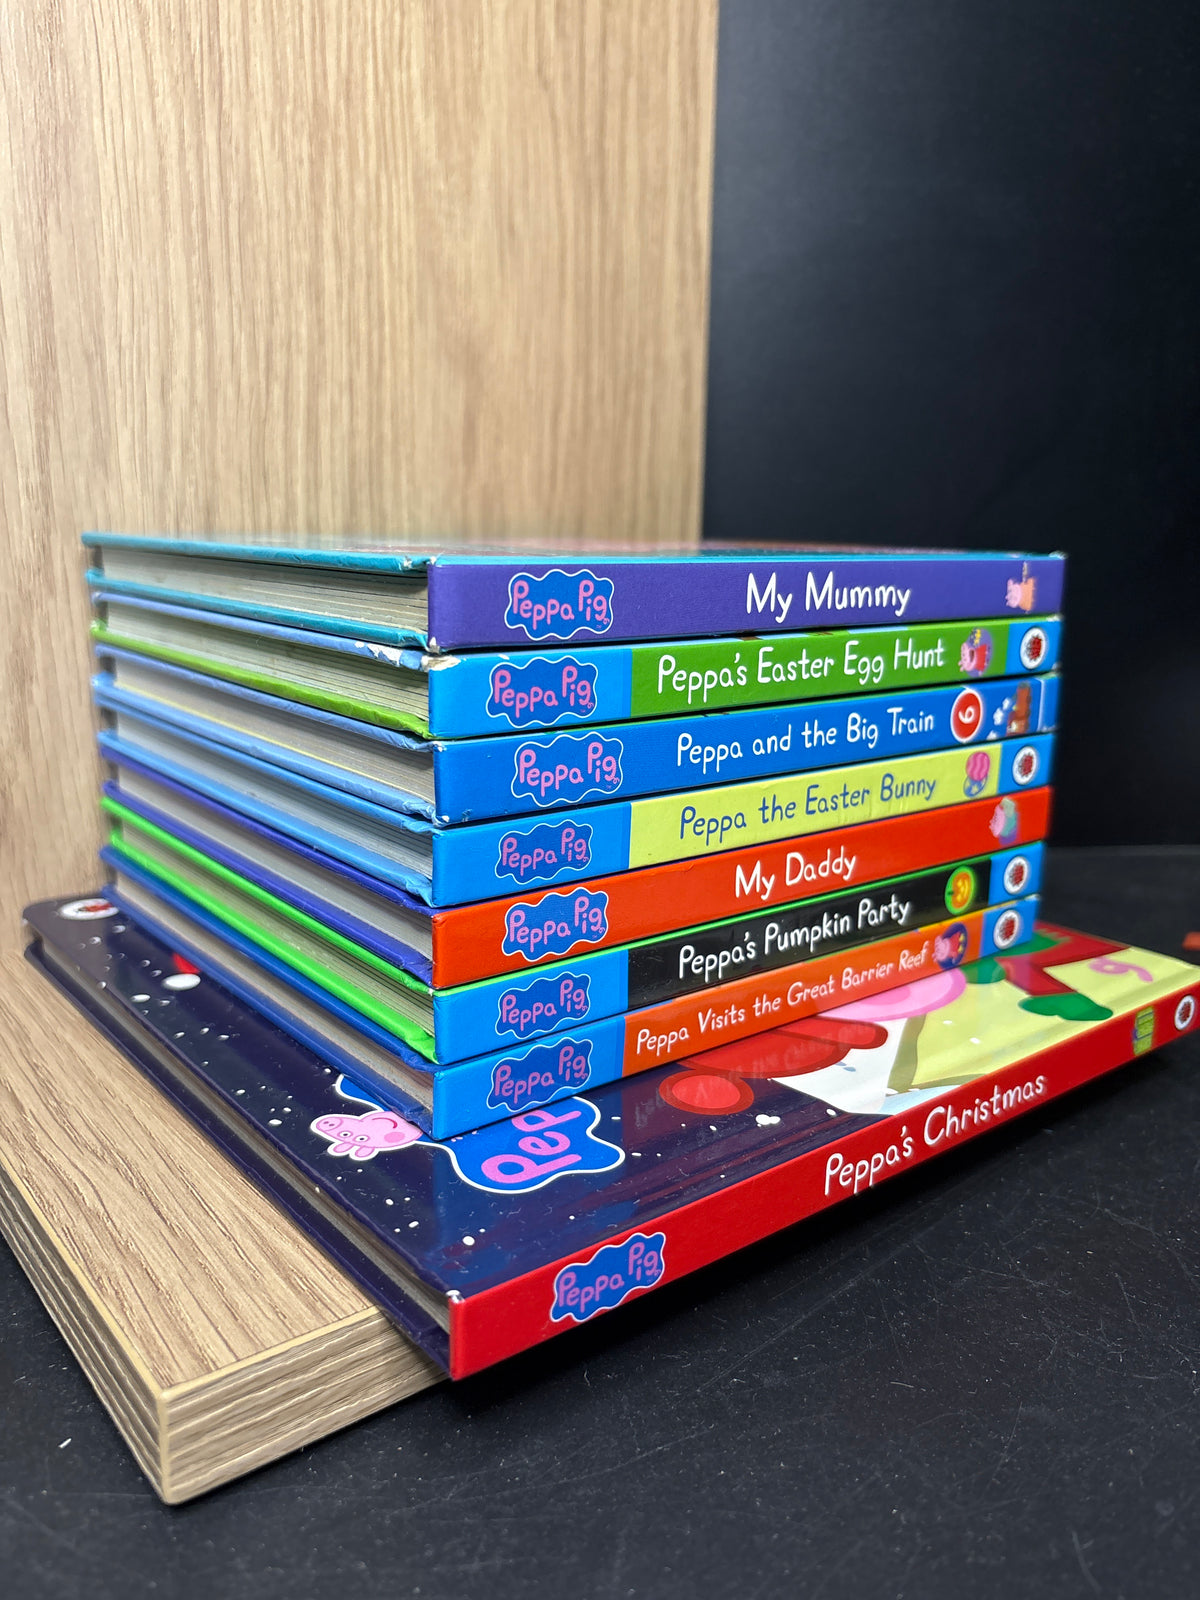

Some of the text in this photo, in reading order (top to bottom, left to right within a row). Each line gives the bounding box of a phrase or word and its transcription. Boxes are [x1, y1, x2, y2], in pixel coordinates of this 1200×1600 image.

[512, 579, 607, 630] Peppa Pig
[746, 570, 912, 624] My Mummy
[493, 665, 591, 719] Peppa Pig
[657, 637, 945, 705] Peppa's Easter Egg Hunt
[519, 741, 617, 797] Peppa Pig
[677, 706, 934, 775] Peppa and the Big Train
[680, 773, 936, 845] Peppa the Easter Bunny
[502, 827, 586, 877] Peppa Pig
[735, 845, 857, 901] My Daddy
[509, 896, 602, 953] Peppa Pig
[678, 894, 910, 984] Peppa's Pumpkin Party
[502, 979, 585, 1031] Peppa Pig
[636, 940, 929, 1057] Peppa Visits the Great Barrier Reef
[494, 1045, 584, 1104] Peppa Pig
[824, 1073, 1045, 1196] Peppa's Christmas
[557, 1241, 660, 1315] Peppa Pig
